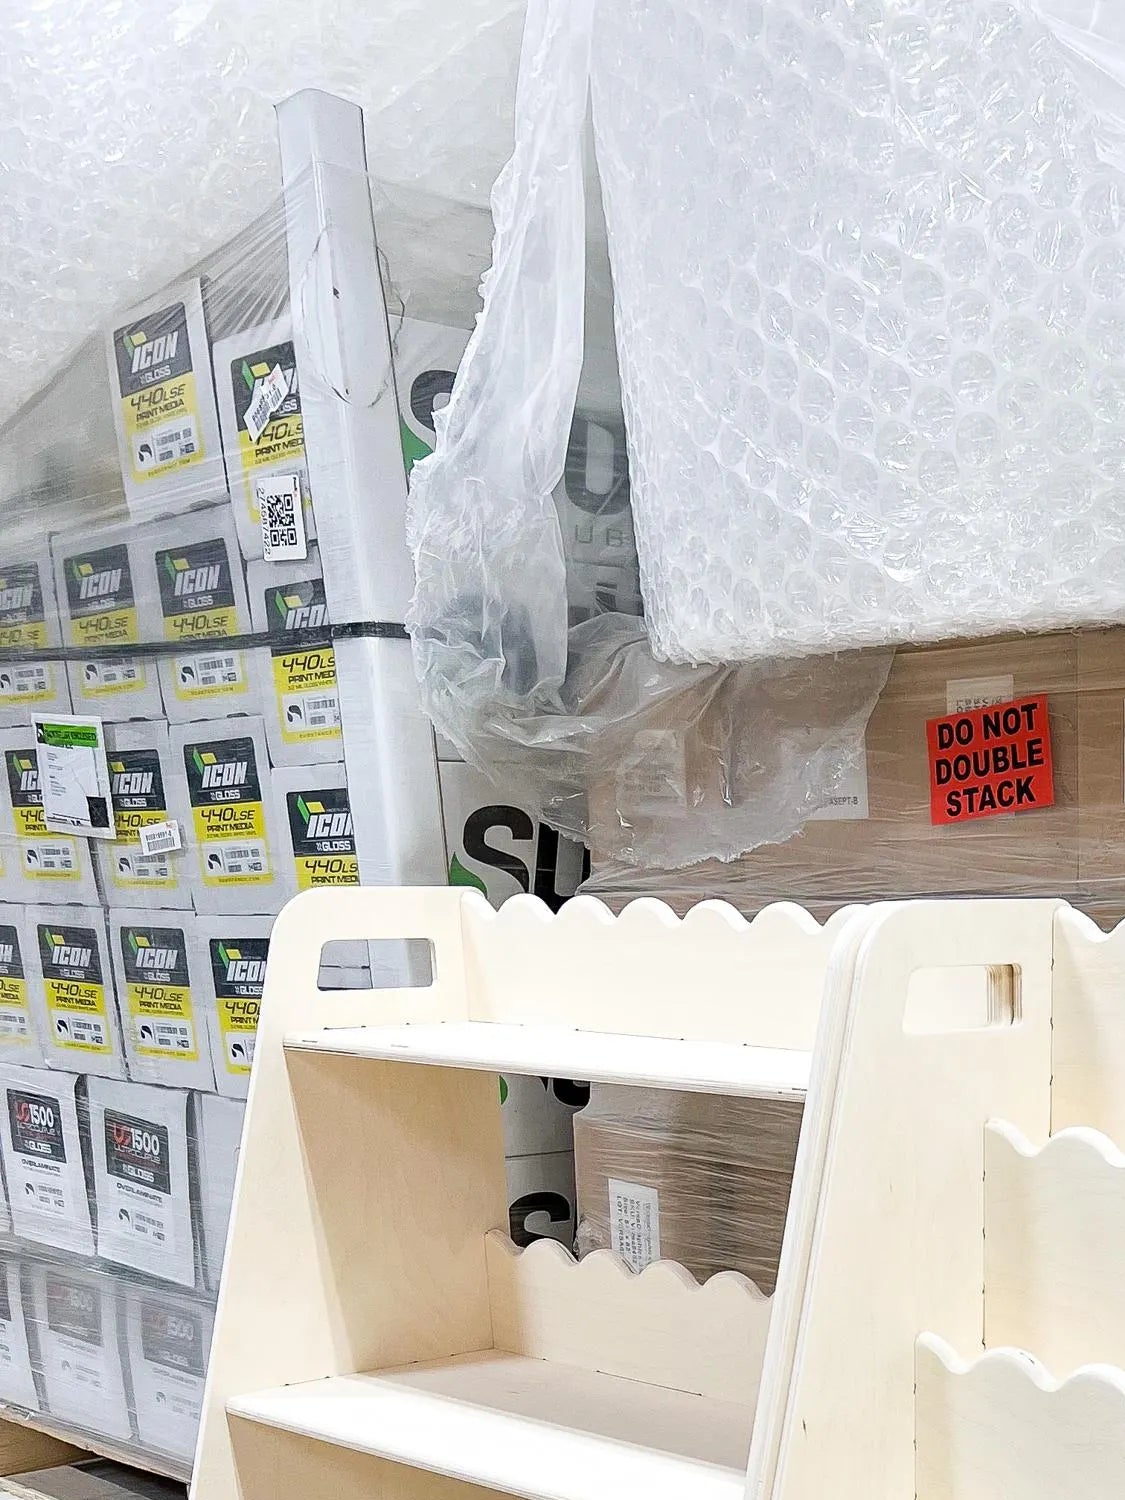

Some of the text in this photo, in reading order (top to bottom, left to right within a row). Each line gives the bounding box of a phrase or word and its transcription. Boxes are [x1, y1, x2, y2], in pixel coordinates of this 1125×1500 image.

[131, 331, 178, 374] ICON
[146, 364, 171, 384] GLOSS
[136, 406, 159, 422] PRINT
[159, 399, 185, 415] MEDIA
[255, 443, 282, 458] PRINT
[283, 437, 304, 451] MED
[79, 568, 122, 600] ICON
[174, 565, 220, 596] ICON
[188, 595, 213, 608] GLOSS
[173, 615, 228, 633] 440LSE
[105, 630, 128, 642] MEDIA
[282, 654, 335, 673] 440LS
[288, 669, 336, 684] PRINT MED
[937, 719, 974, 750] DO
[983, 703, 1038, 741] NOT
[935, 738, 1044, 785] DOUBLE
[113, 772, 153, 794] ICON
[202, 762, 248, 788] ICON
[125, 798, 147, 807] GLOSS
[216, 790, 240, 801] GLOSS
[946, 776, 1036, 817] STACK
[201, 808, 255, 822] 440LSE
[207, 822, 254, 832] PRINT MEDIA
[322, 840, 351, 851] GLOSS
[305, 859, 358, 874] 440LS
[311, 875, 335, 884] PRINT
[52, 946, 92, 968] ICON
[135, 947, 178, 970] ICON
[64, 969, 85, 979] GLOSS
[148, 971, 170, 982] GLOSS
[51, 982, 98, 999] 440LSE
[134, 986, 184, 1002] 440LSE
[56, 995, 96, 1007] PRINT MEDIA
[139, 1000, 182, 1010] PRINT MEDIA
[230, 1016, 252, 1024] PRINT
